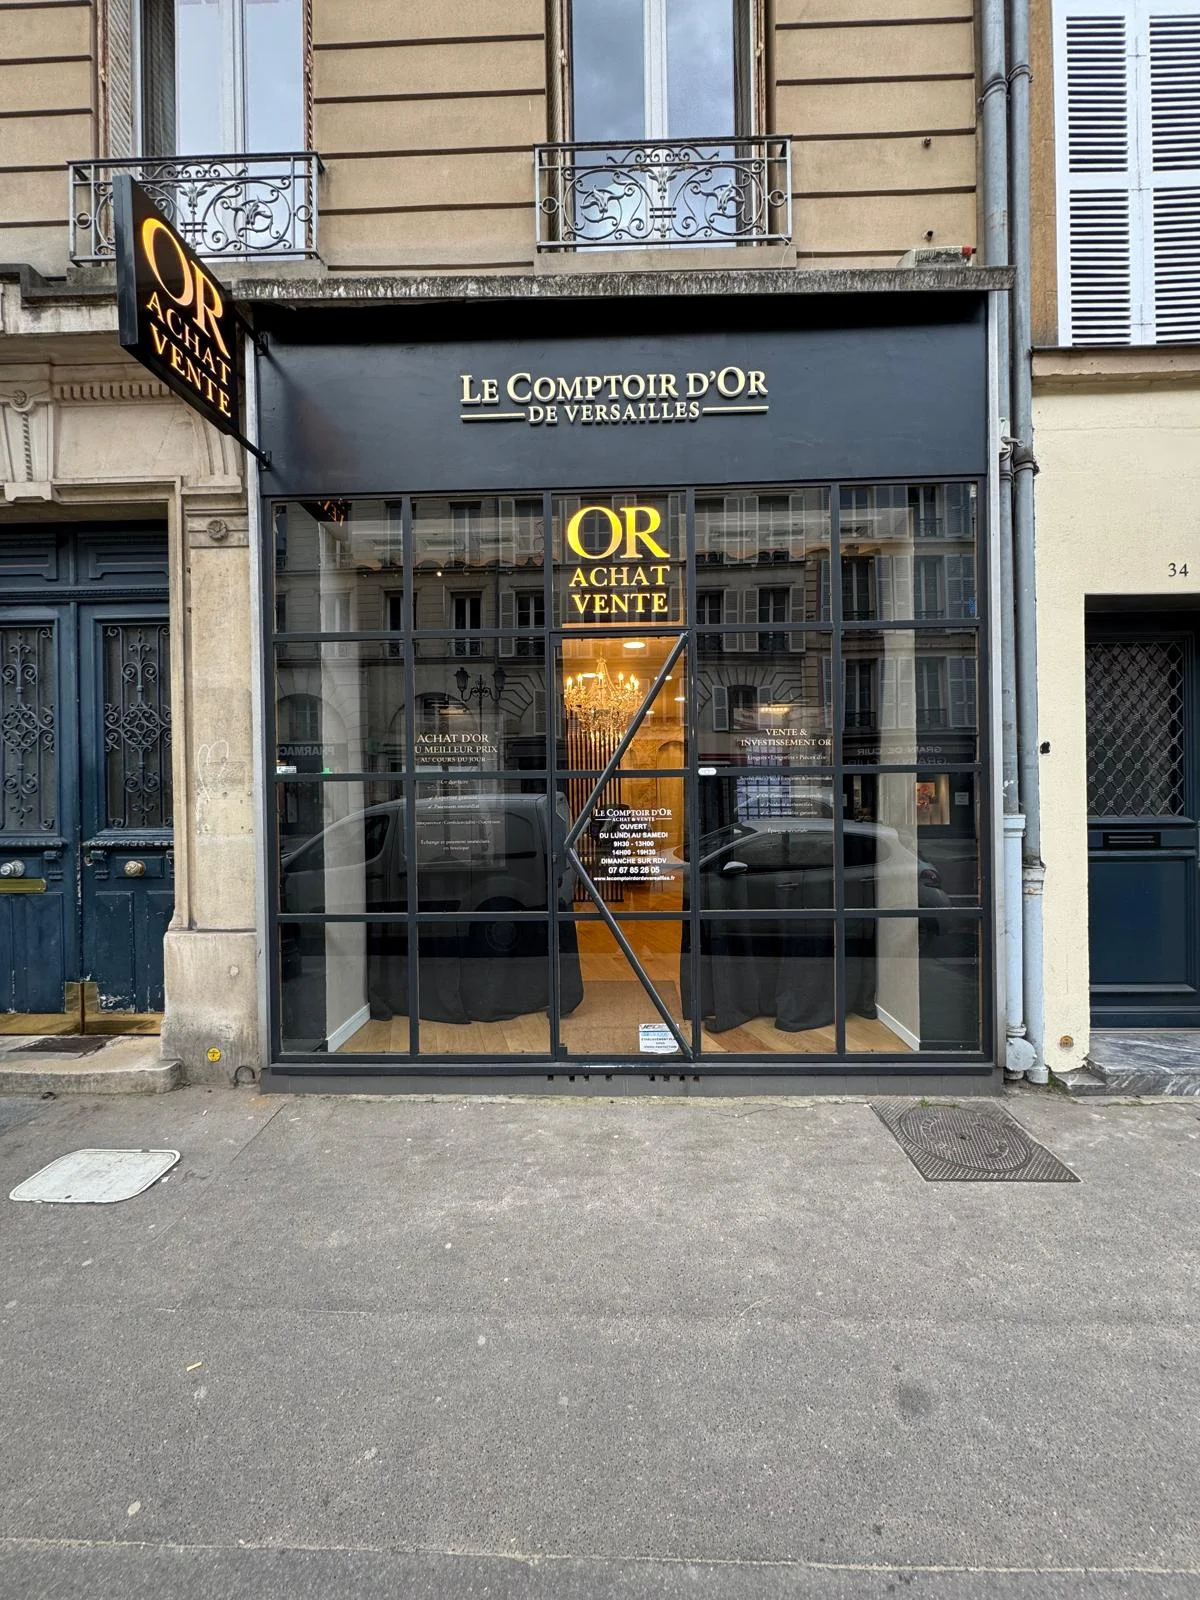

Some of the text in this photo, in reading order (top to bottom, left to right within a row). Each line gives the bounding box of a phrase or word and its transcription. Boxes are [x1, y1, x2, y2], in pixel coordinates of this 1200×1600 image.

[142, 218, 231, 360] OR
[147, 291, 231, 386] ACHAT
[150, 322, 231, 418] VENTE
[460, 366, 769, 404] LE COMPTOIR D'OR
[528, 401, 700, 424] DE VERSAILLES
[567, 506, 671, 559] OR
[569, 565, 670, 587] ACHAT
[1168, 562, 1189, 577] 34
[572, 593, 668, 614] VENTE
[416, 733, 489, 743] ACHAT D'OR
[424, 746, 473, 754] MEILLEUR
[476, 745, 498, 753] PRIX
[595, 808, 672, 817] LE COMPTOIR D'OR
[608, 866, 618, 874] 07
[650, 866, 660, 874] 05
